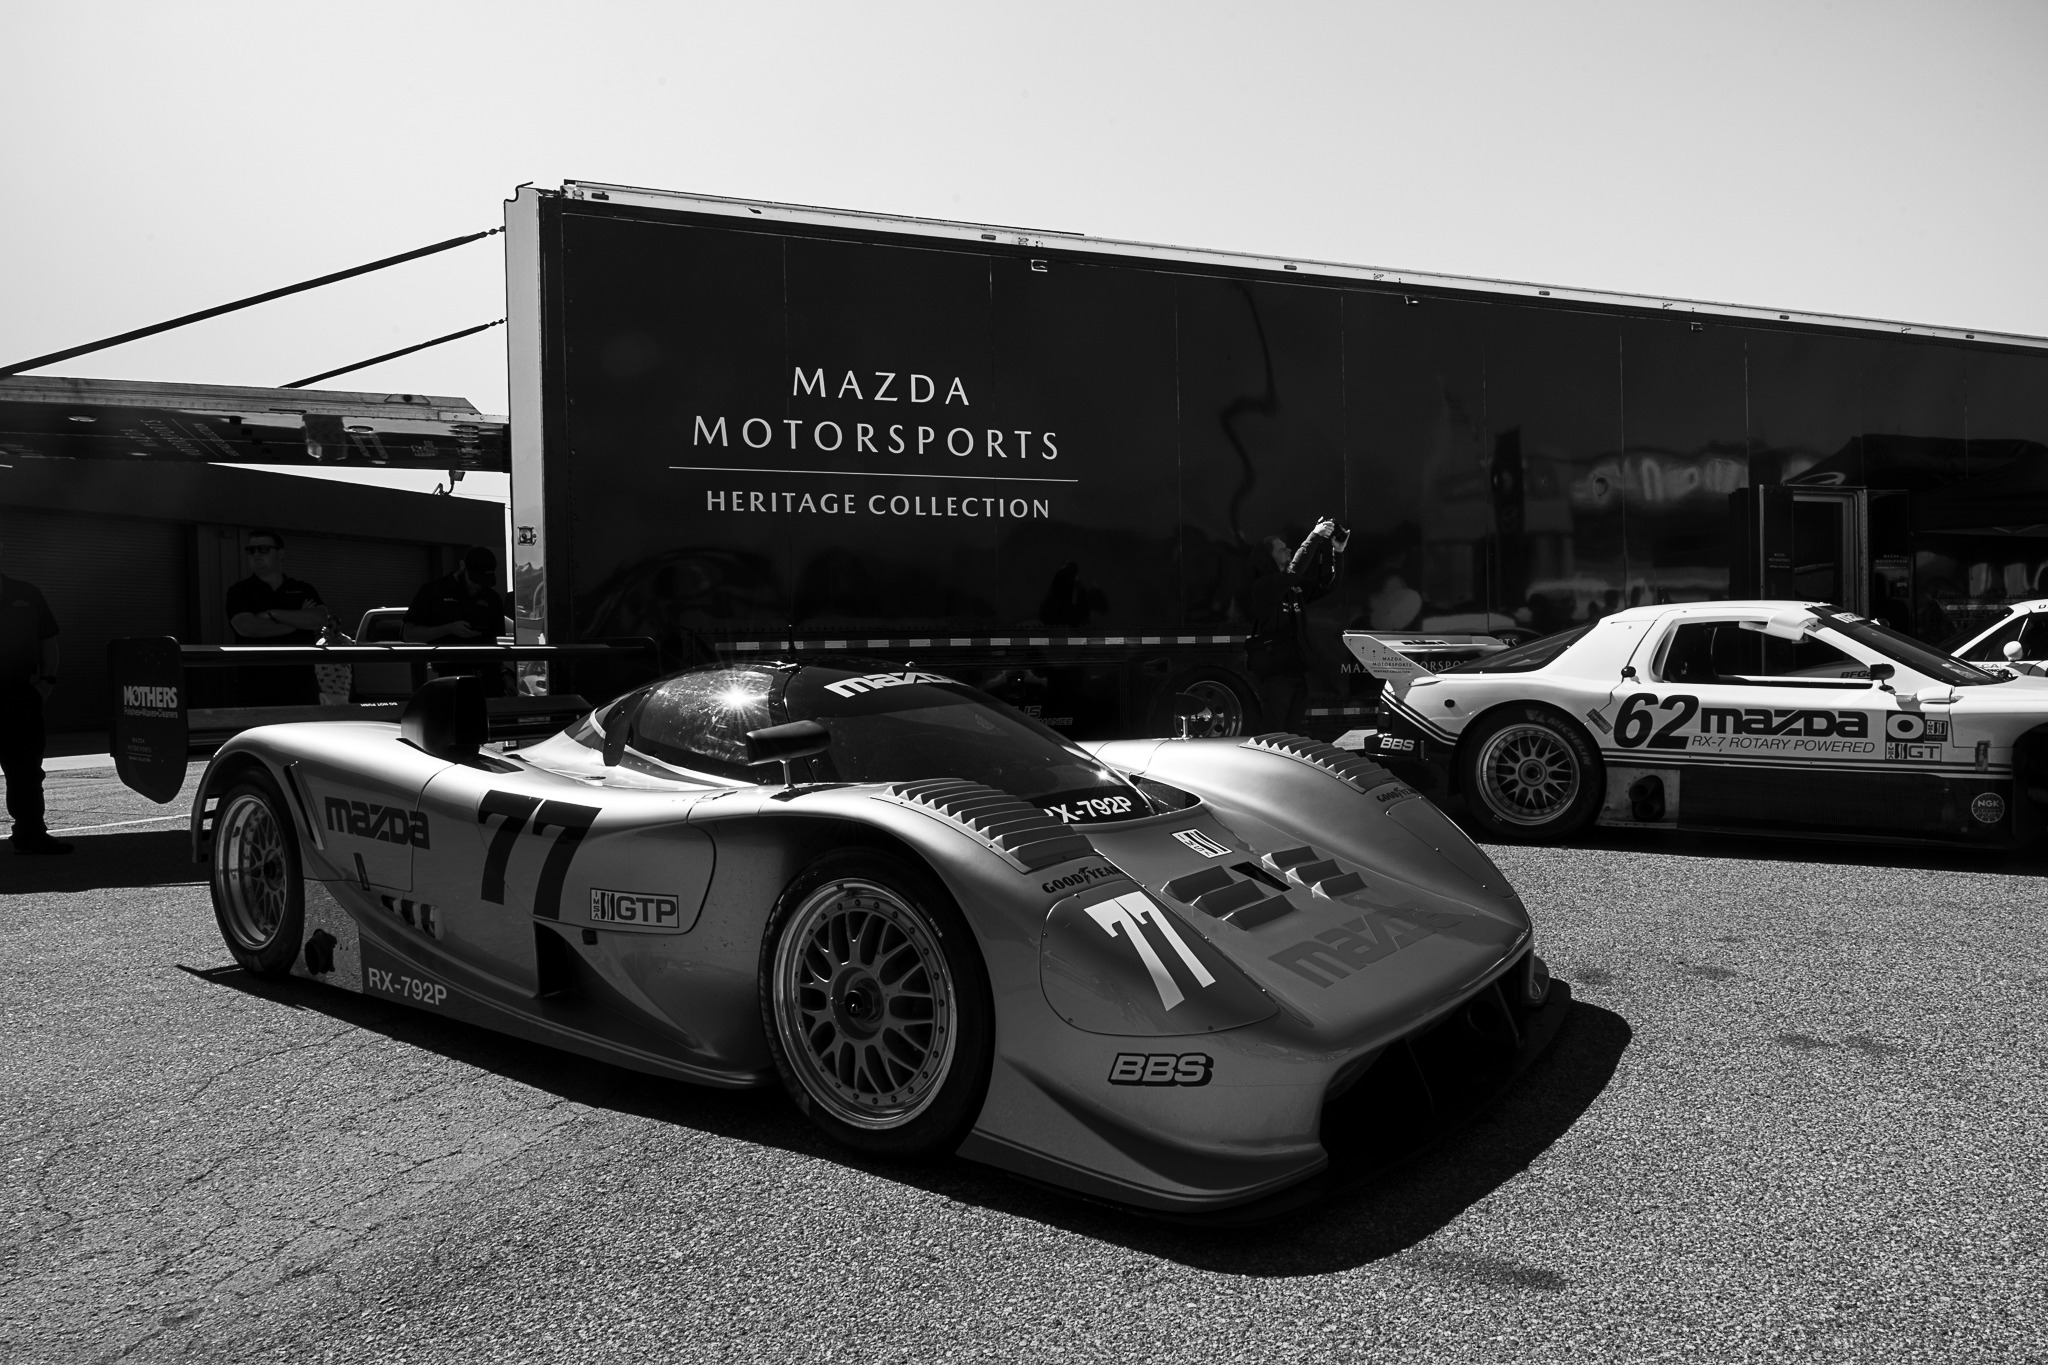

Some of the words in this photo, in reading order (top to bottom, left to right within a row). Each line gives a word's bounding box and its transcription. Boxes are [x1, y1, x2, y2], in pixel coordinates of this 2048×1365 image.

[793, 366, 970, 406] MAZDA
[693, 415, 1059, 460] MOTORSPORTS
[707, 490, 857, 514] HERITAGE
[868, 495, 1049, 519] COLLECTION
[123, 685, 178, 709] MOTHERS
[1613, 692, 1699, 750] 62
[1380, 737, 1415, 751] BBS
[1692, 736, 1725, 748] RX-7
[1729, 737, 1791, 751] ROTARY
[1794, 739, 1876, 753] POWERED
[1909, 745, 1940, 759] GT
[1044, 795, 1132, 824] X-792P
[1977, 799, 2000, 808] NGK
[478, 789, 602, 921] 77
[616, 895, 676, 923] GTP
[1083, 890, 1217, 1012] 77
[368, 967, 447, 1006] RX-792P
[1107, 1052, 1215, 1088] BBS
